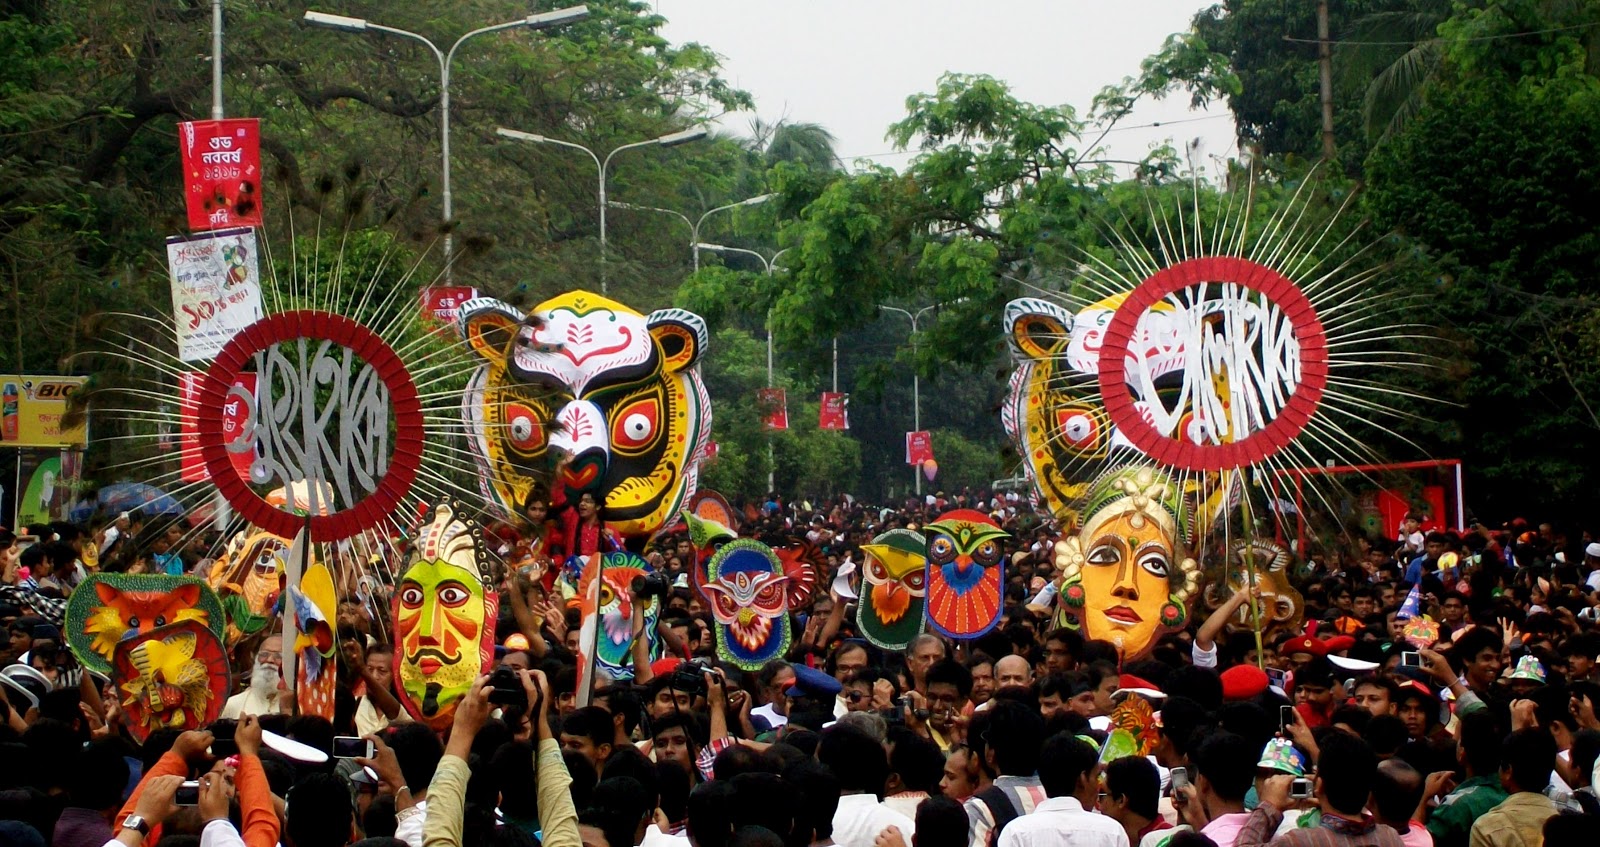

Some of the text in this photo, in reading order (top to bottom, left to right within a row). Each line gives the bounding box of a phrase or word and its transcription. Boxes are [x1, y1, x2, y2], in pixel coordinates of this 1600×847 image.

[209, 137, 232, 149] শুভ
[201, 148, 242, 164] নববর্ষ
[204, 166, 240, 180] ১৪১৮
[209, 209, 228, 224] রবি
